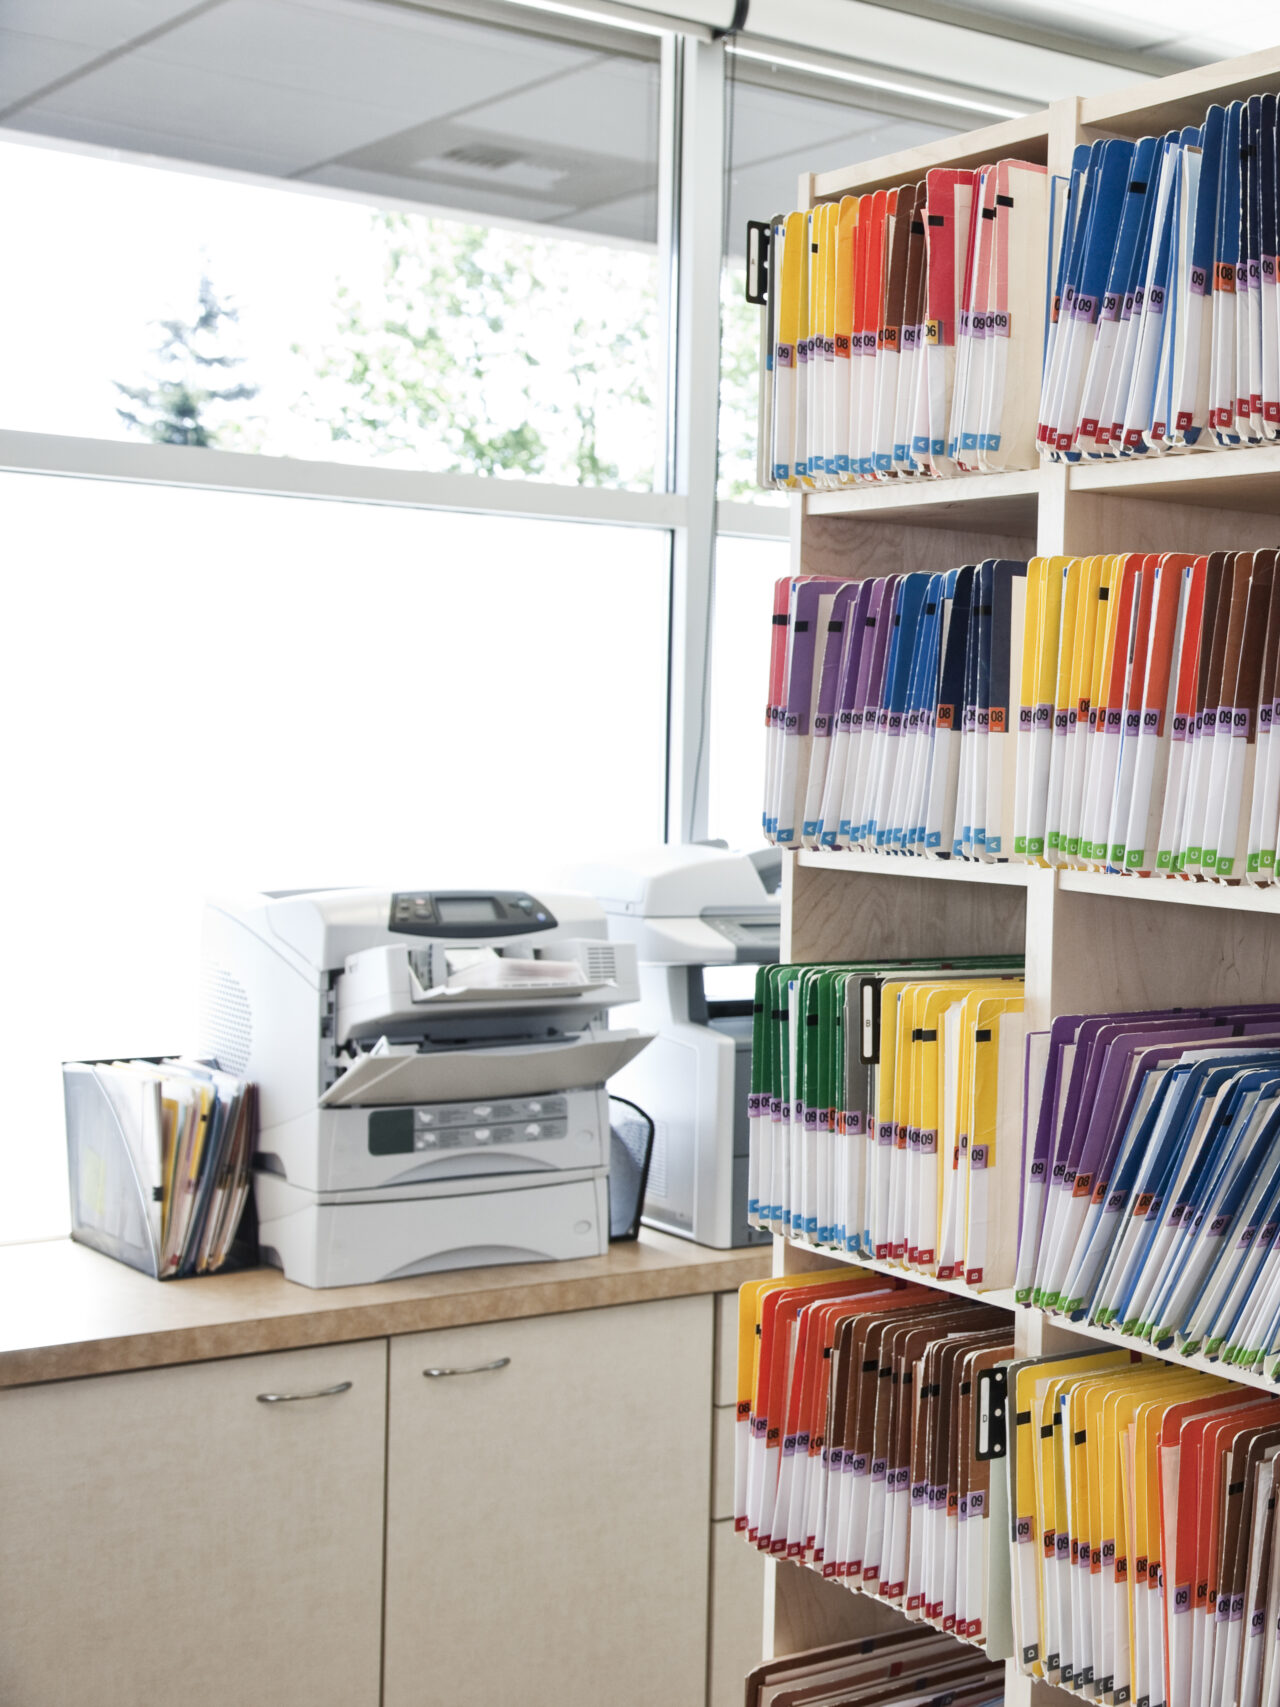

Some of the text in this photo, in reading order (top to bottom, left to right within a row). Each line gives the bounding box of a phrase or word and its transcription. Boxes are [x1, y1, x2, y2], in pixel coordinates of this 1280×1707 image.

[1263, 260, 1274, 274] 09
[1192, 271, 1204, 286] 09
[1221, 267, 1233, 280] 08
[1151, 290, 1164, 304] 09
[1078, 299, 1092, 312] 09
[1104, 297, 1116, 310] 09
[973, 317, 985, 329] 09
[995, 314, 1007, 327] 09
[884, 328, 896, 340] 08
[836, 337, 848, 349] 08
[864, 335, 876, 347] 09
[778, 347, 789, 358] 09
[939, 708, 950, 718] 08
[978, 713, 989, 725] 09
[991, 711, 1003, 722] 08
[1037, 709, 1048, 720] 09
[1108, 713, 1121, 724] 09
[1220, 711, 1232, 724] 09
[786, 716, 797, 727] 09
[815, 718, 826, 728] 09
[890, 716, 900, 727] 09
[1056, 715, 1067, 727] 09
[1128, 714, 1140, 727] 09
[1144, 713, 1157, 726] 09
[1174, 718, 1186, 730] 09
[1204, 713, 1216, 726] 09
[1234, 714, 1246, 726] 09
[1131, 854, 1138, 862] C
[806, 1111, 816, 1122] 09
[847, 1115, 859, 1126] 09
[880, 1126, 892, 1138] 09
[921, 1134, 933, 1145] 09
[972, 1150, 983, 1161] 09
[1032, 1163, 1044, 1174] 09
[1054, 1164, 1066, 1176] 09
[1064, 1171, 1075, 1182] 09
[1078, 1176, 1090, 1187] 08
[1109, 1195, 1121, 1206] 09
[738, 1403, 750, 1414] 08
[983, 1414, 988, 1422] D
[785, 1438, 796, 1448] 09
[798, 1434, 809, 1445] 09
[854, 1458, 865, 1469] 09
[873, 1462, 884, 1473] 09
[897, 1471, 908, 1482] 09
[913, 1487, 924, 1498] 09
[936, 1488, 947, 1501] 09
[971, 1495, 982, 1507] 09
[1018, 1523, 1029, 1535] 09
[1057, 1536, 1068, 1550] 09
[1103, 1544, 1114, 1557] 09
[1137, 1559, 1147, 1573] 08
[1176, 1591, 1188, 1604] 09
[1219, 1598, 1230, 1612] 09
[1232, 1598, 1244, 1612] 09
[1253, 1613, 1264, 1626] 09
